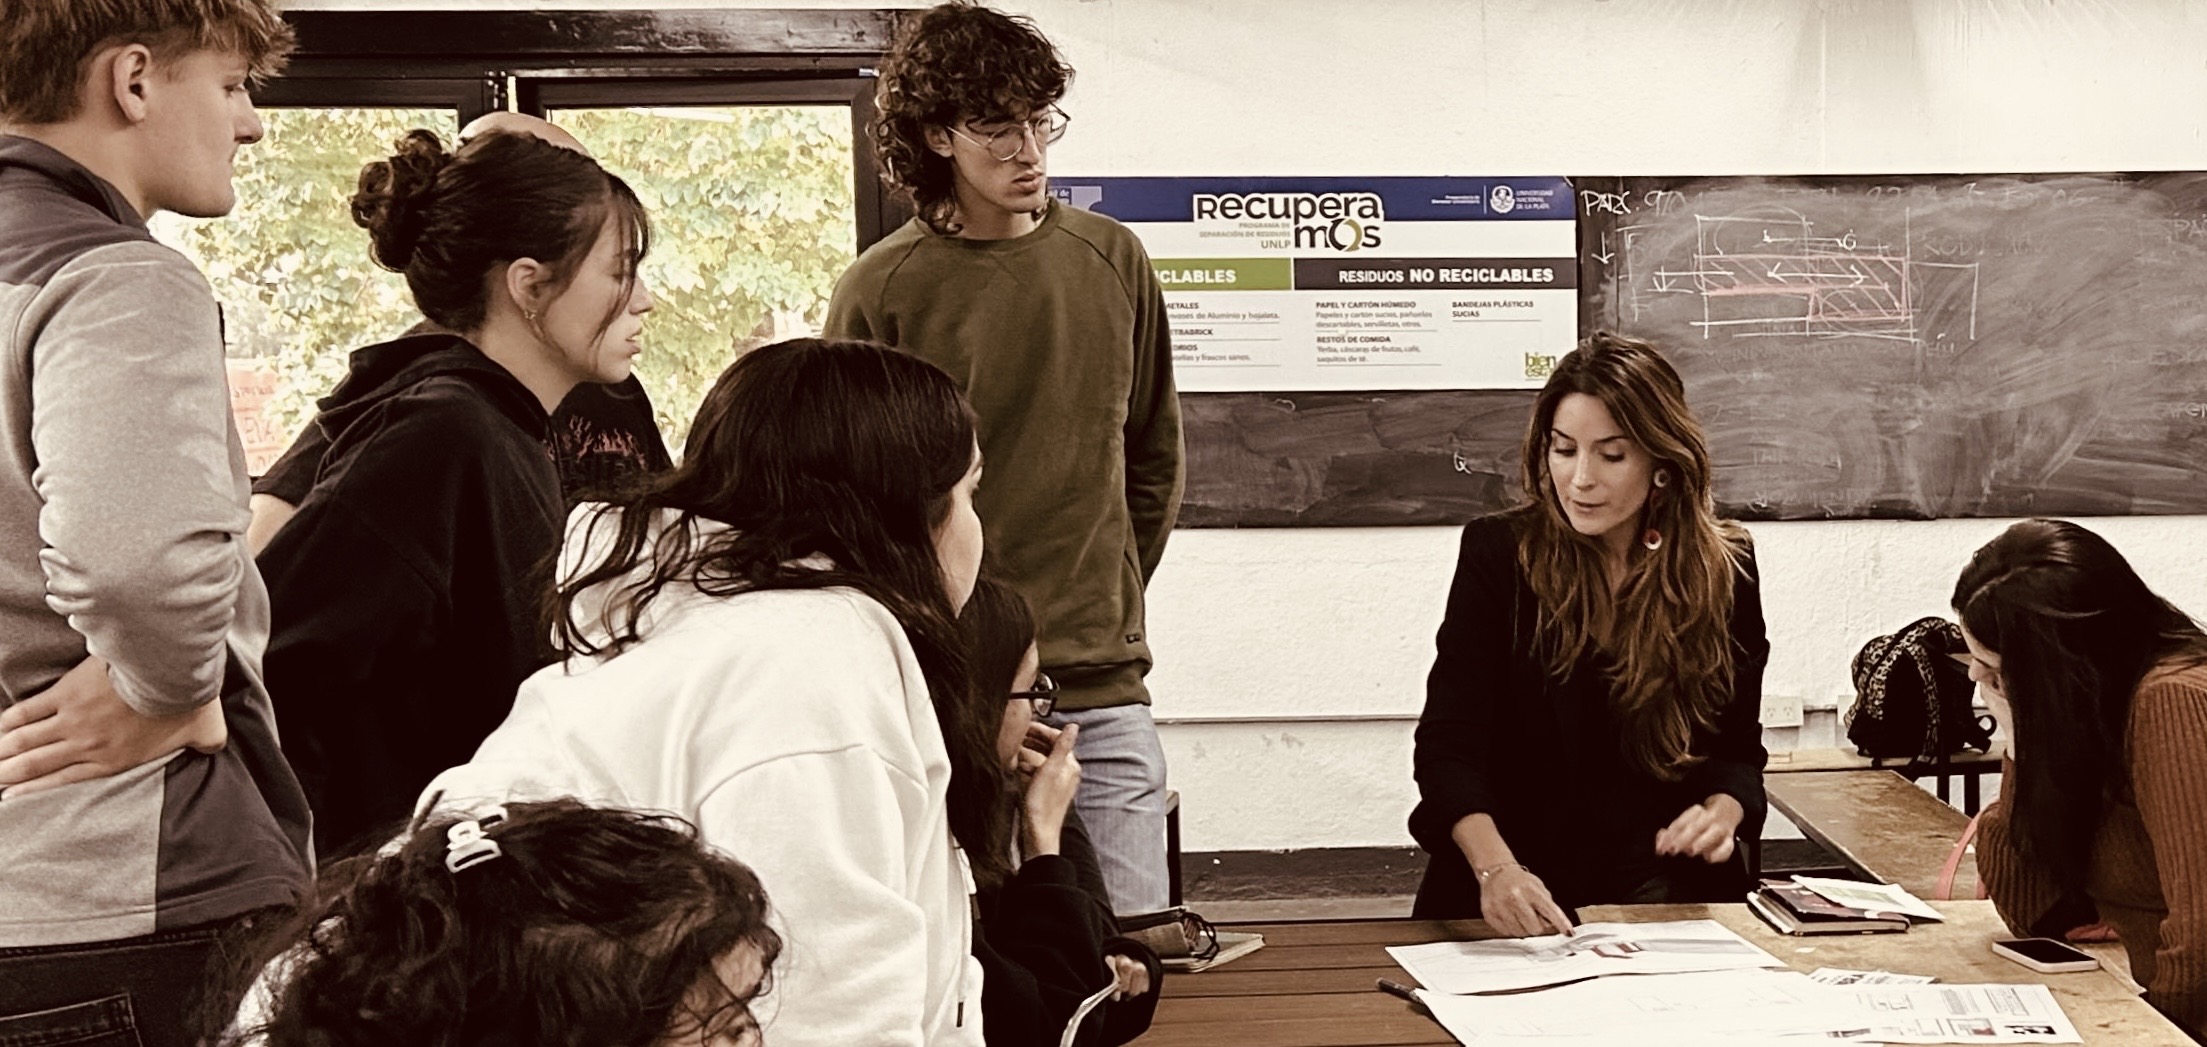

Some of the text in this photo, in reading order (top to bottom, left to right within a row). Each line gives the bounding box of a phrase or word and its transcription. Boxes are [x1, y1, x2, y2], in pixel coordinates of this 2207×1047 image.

[1261, 240, 1291, 249] UNLP
[1339, 268, 1554, 283] RESIDUOS NO RECICLABLES
[1347, 300, 1380, 309] CARTÓN
[1381, 300, 1417, 309] HÚMEDO
[1493, 300, 1534, 308] PLÁSTICAS
